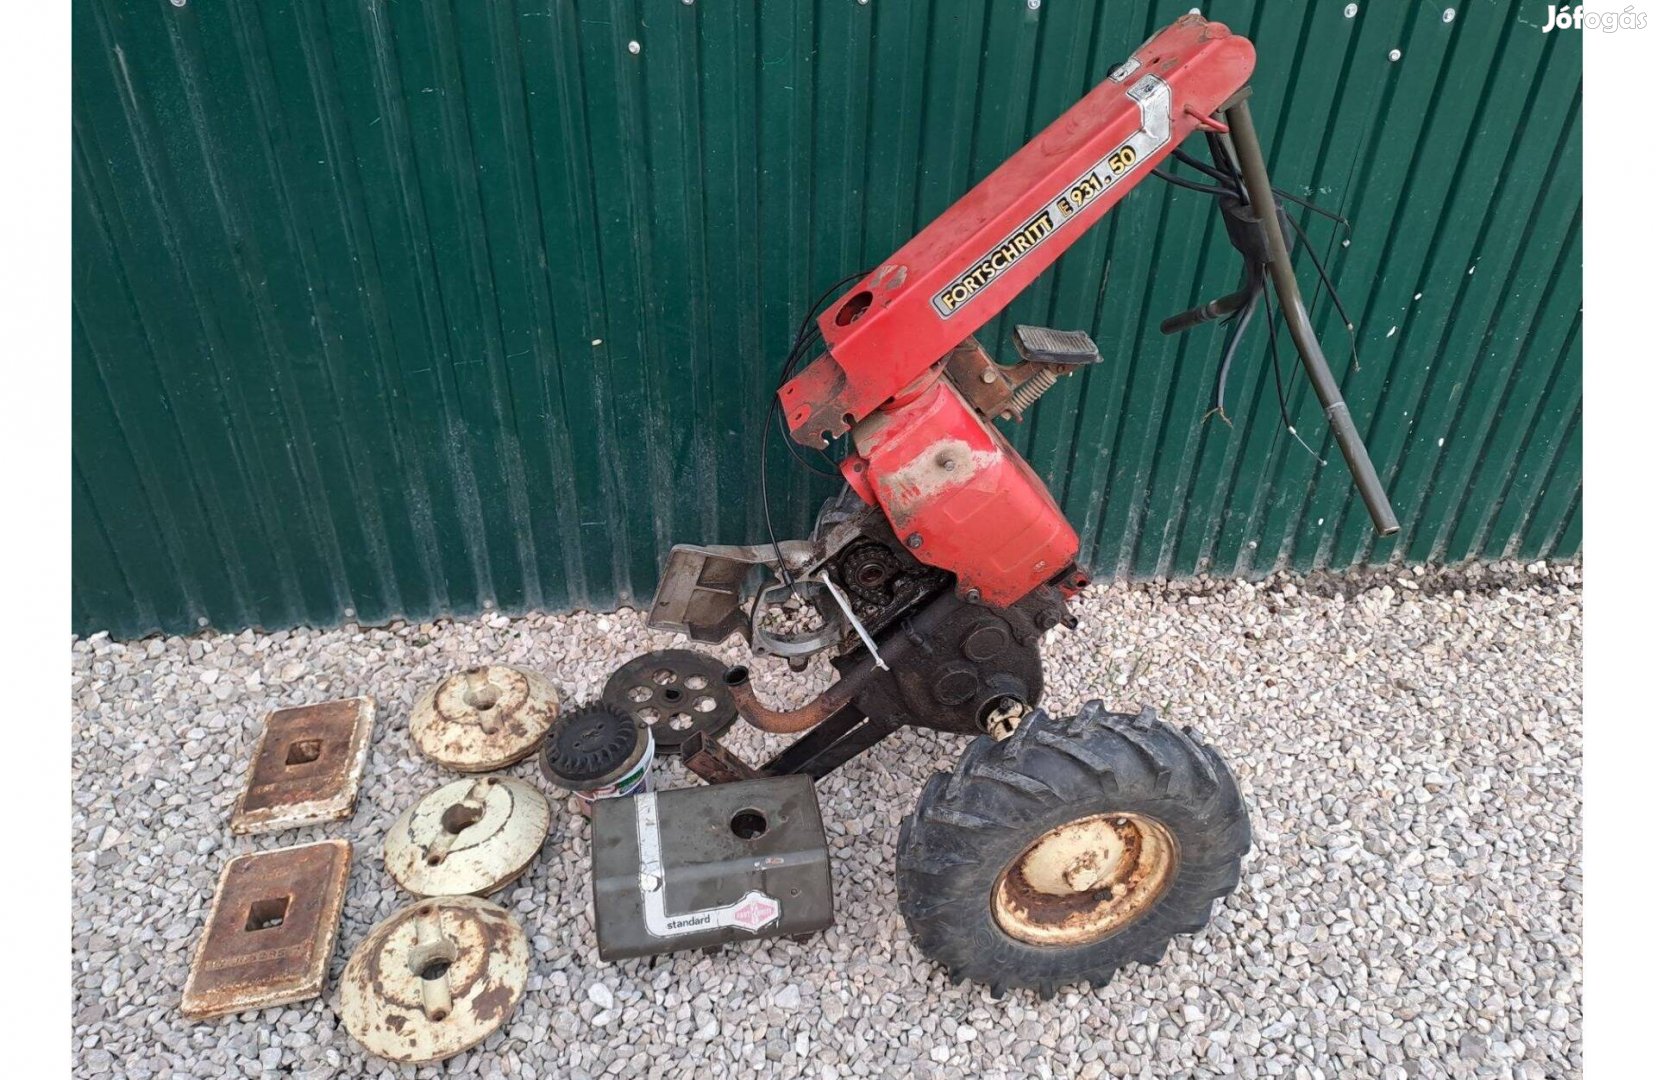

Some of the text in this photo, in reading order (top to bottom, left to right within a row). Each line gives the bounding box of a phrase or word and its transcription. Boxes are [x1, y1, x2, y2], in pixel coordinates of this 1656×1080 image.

[941, 212, 1054, 310] FORTSCHRITT
[1057, 198, 1074, 217] E
[667, 914, 711, 930] standard
